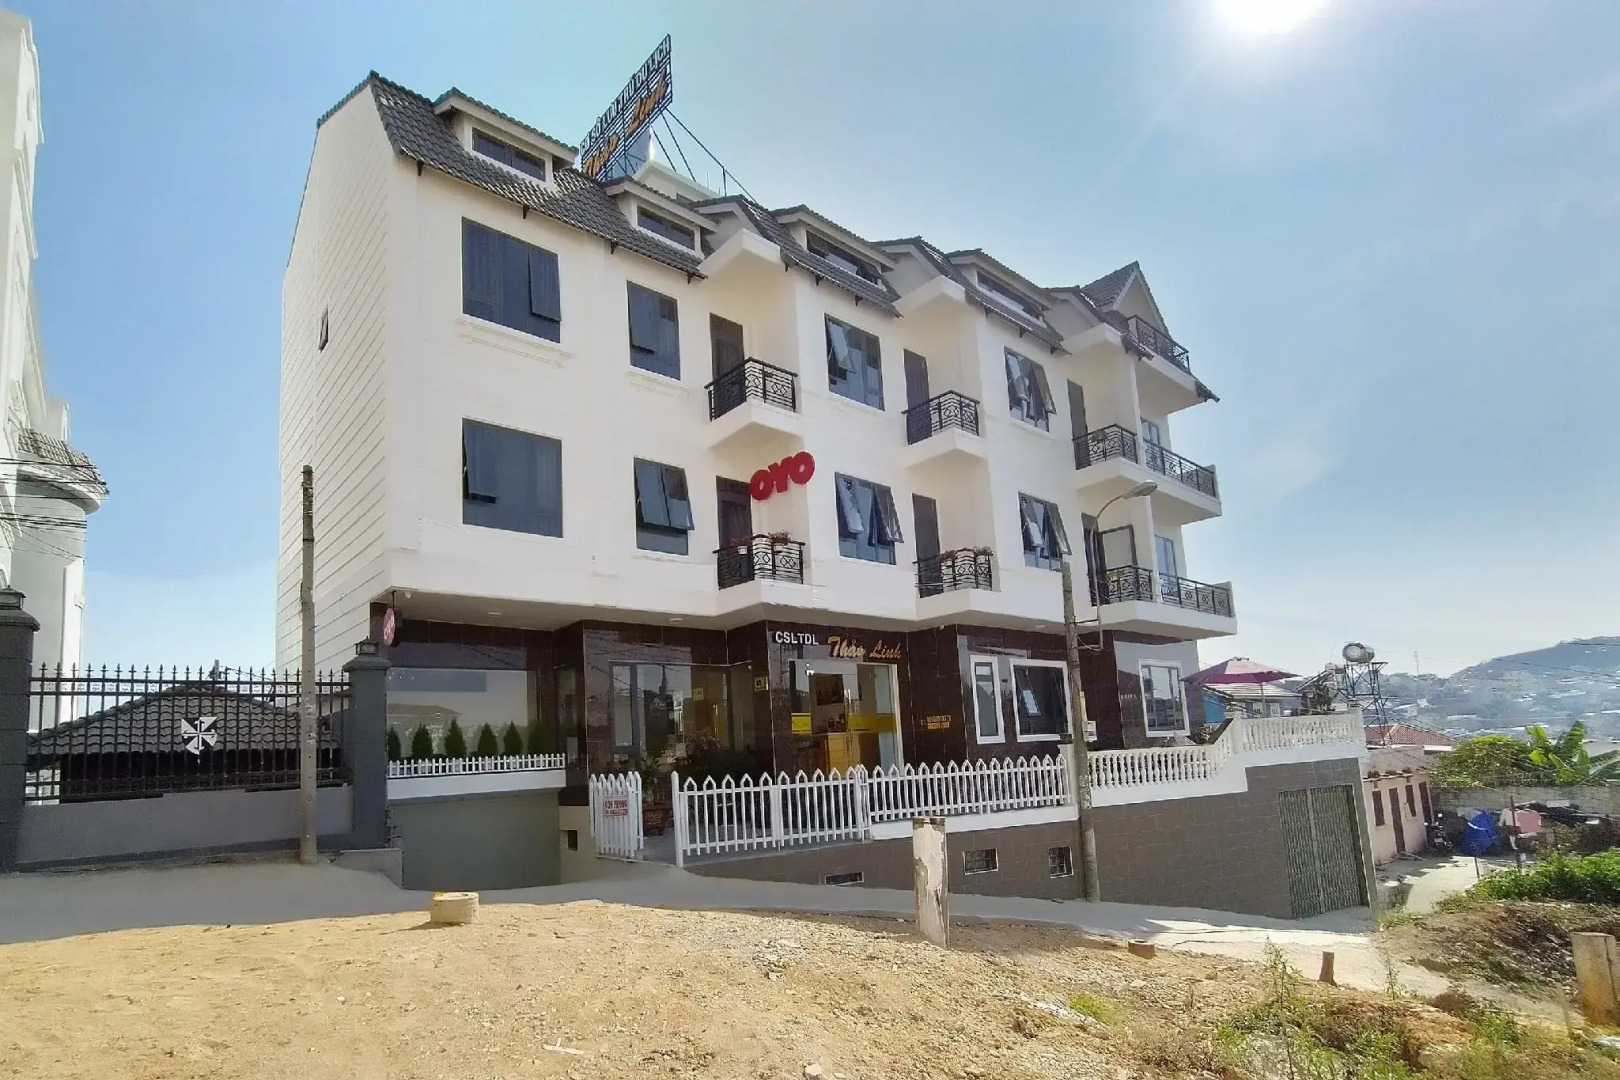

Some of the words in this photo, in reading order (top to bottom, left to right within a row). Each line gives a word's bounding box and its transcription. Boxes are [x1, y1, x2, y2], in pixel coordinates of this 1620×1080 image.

[750, 451, 815, 501] OYO
[775, 631, 819, 645] CSLTDL
[827, 636, 866, 657] Thảo
[869, 640, 902, 659] Linh
